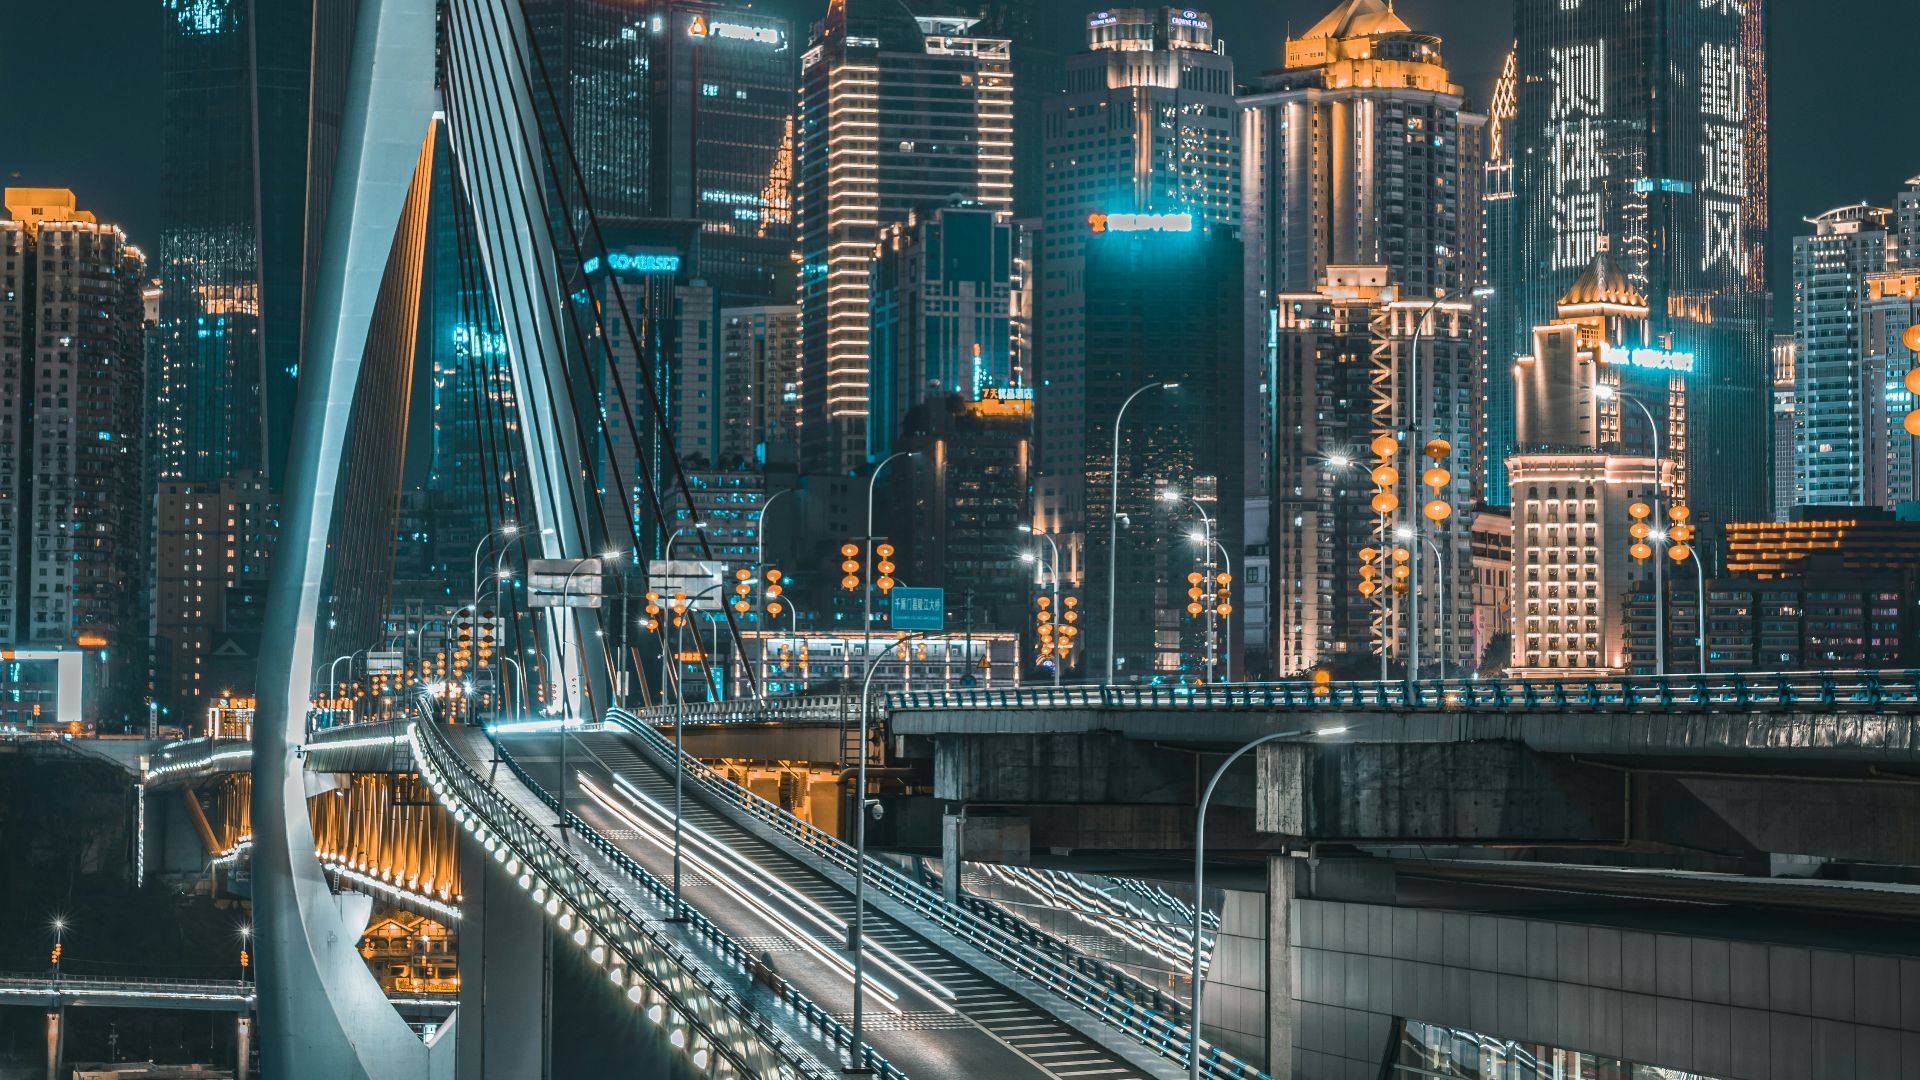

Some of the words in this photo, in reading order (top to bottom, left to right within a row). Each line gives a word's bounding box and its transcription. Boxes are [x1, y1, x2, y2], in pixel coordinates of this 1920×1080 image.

[1105, 16, 1117, 24] PLAZA
[1171, 17, 1192, 26] CROWNE
[1192, 19, 1208, 29] PLAZA
[1551, 38, 1609, 270] 测体温
[1701, 42, 1749, 276] 勤通风
[608, 253, 680, 272] SOMERSET
[895, 597, 940, 611] 千厮门嘉陵江大桥
